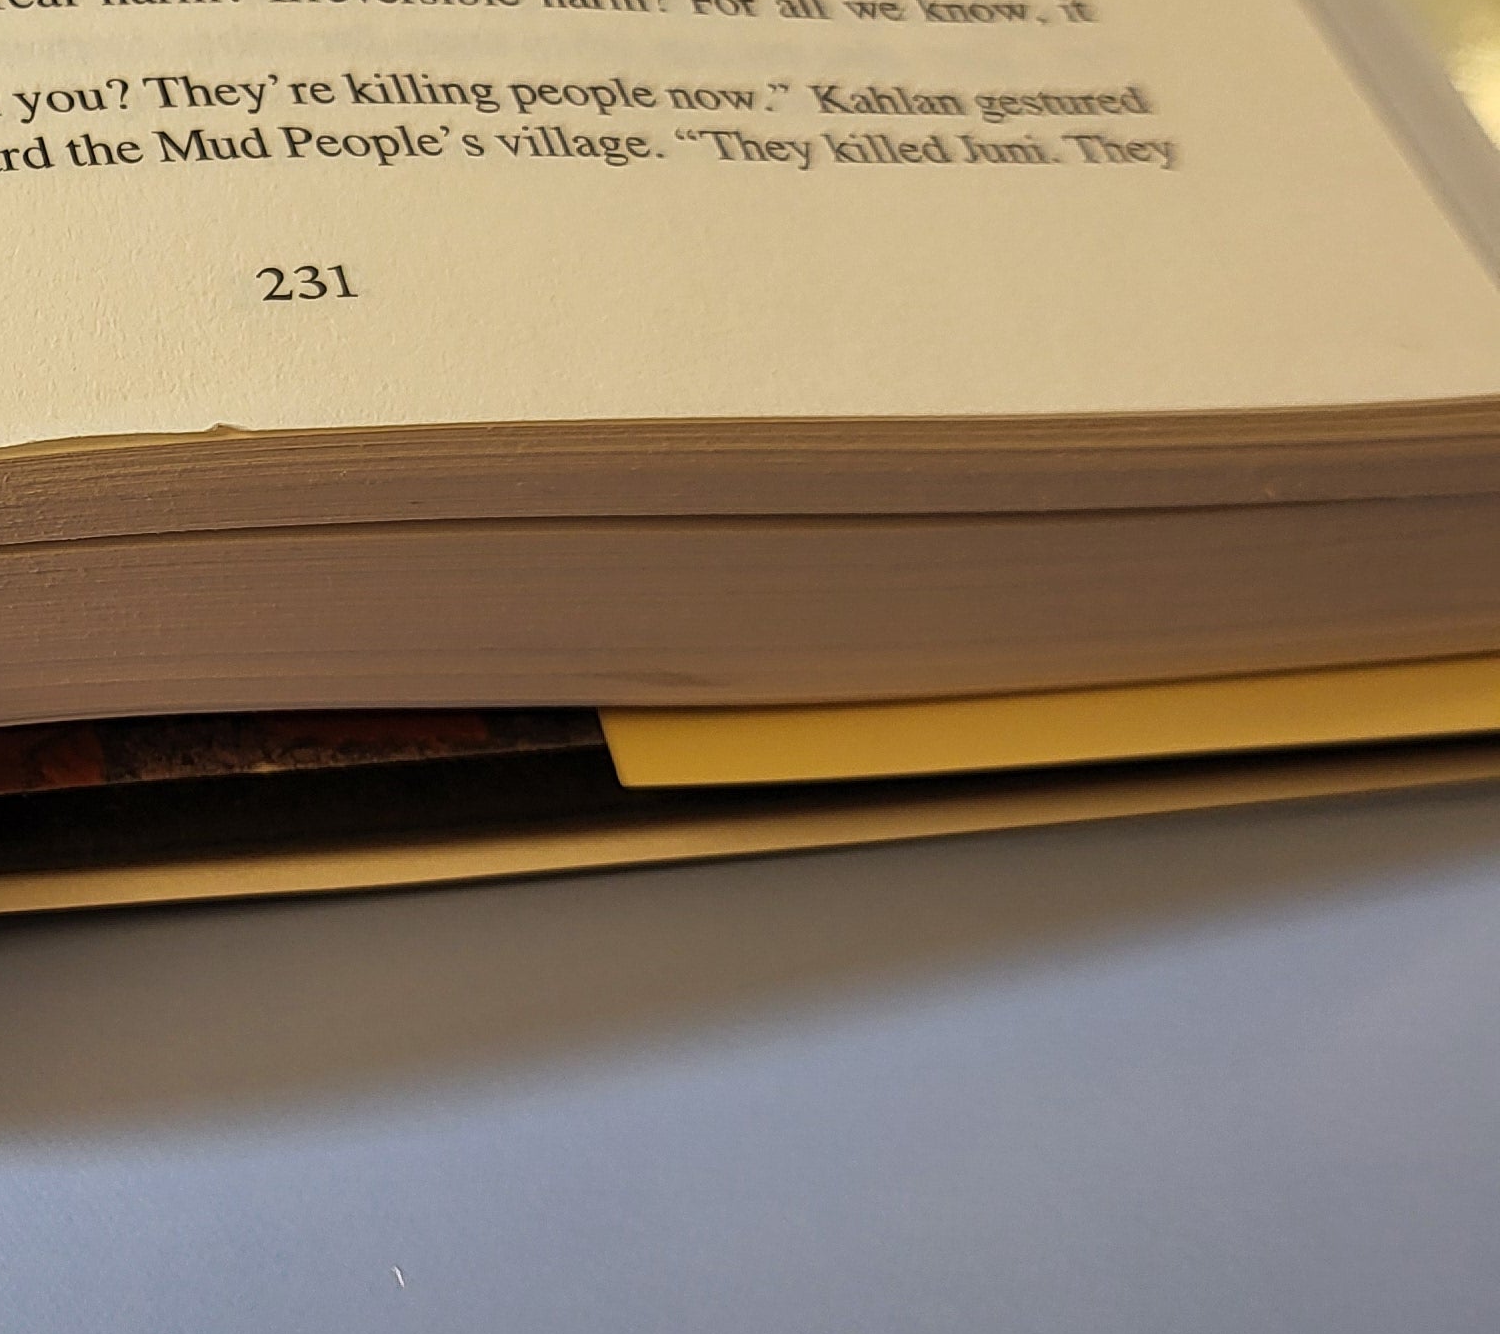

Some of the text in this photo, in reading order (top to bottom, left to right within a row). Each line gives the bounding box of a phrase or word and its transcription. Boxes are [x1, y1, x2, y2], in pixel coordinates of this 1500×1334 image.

[842, 0, 907, 22] we
[11, 78, 129, 125] you?
[141, 73, 336, 115] They’re
[341, 72, 501, 114] killing
[507, 76, 658, 116] people
[807, 84, 967, 116] Kahlan
[973, 86, 1154, 124] gestured
[65, 133, 144, 167] the
[151, 126, 273, 163] Mud
[277, 124, 485, 167] People’s
[493, 125, 665, 167] village.
[820, 132, 955, 164] killed
[1060, 134, 1178, 171] They
[255, 264, 359, 302] 231
